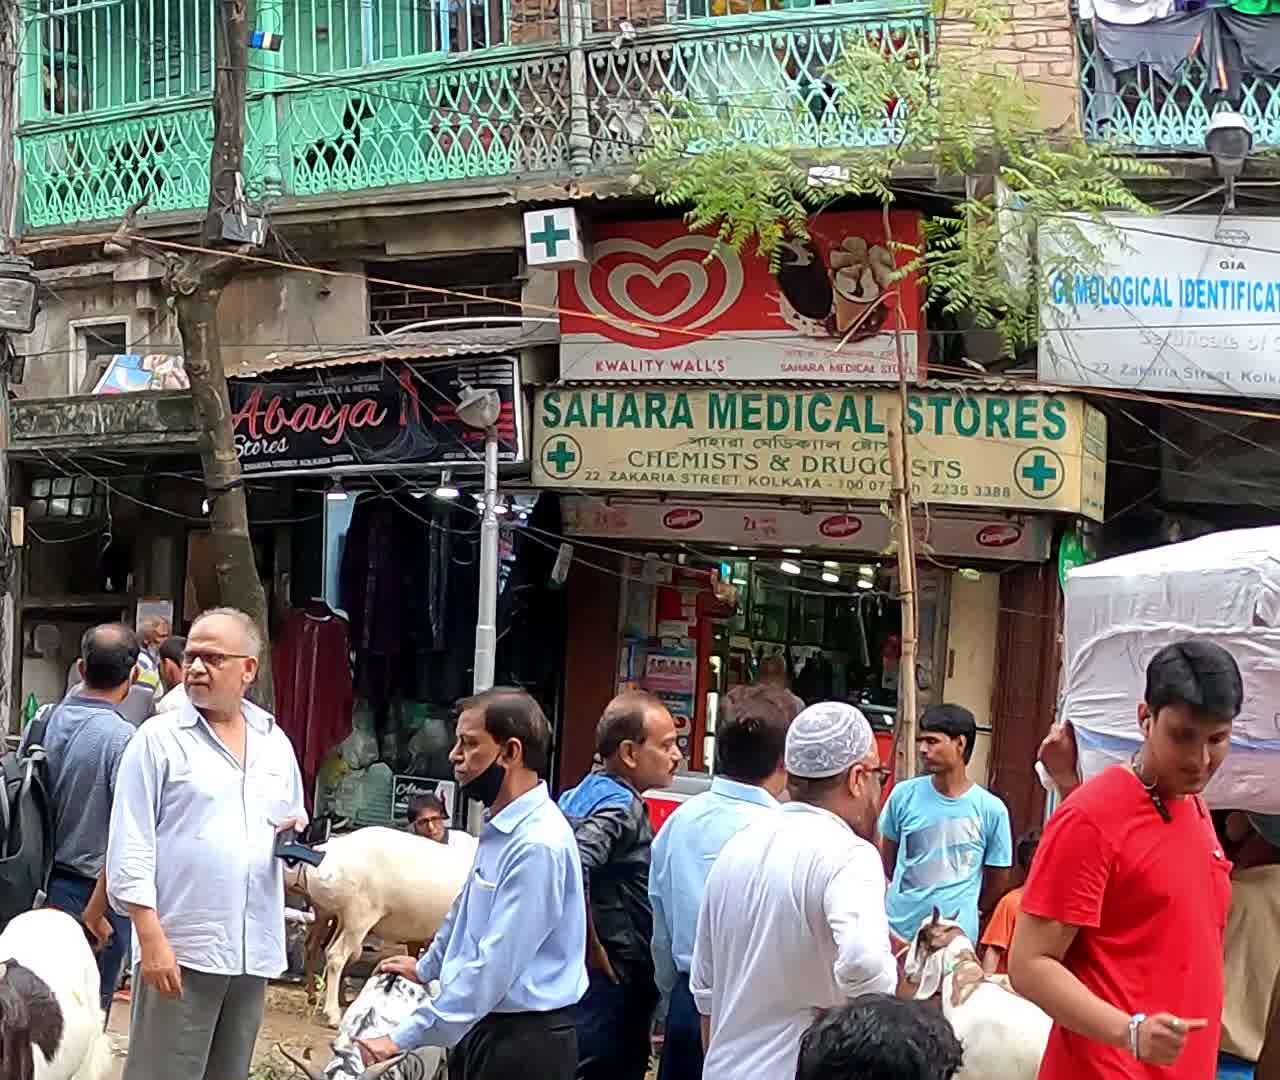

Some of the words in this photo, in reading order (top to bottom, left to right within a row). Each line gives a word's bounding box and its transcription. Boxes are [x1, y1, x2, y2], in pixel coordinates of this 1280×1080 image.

[1219, 260, 1247, 271] GIA
[1052, 274, 1173, 308] GMOLOGICAL
[595, 359, 664, 372] KWALITY
[670, 359, 726, 373] WALL'S
[232, 386, 388, 444] Abaya
[542, 391, 693, 429] SAHARA
[708, 392, 886, 434] MEDICAL
[905, 394, 1067, 441] STORES
[233, 433, 289, 458] Stores
[628, 449, 759, 471] CHEMISTS
[769, 453, 790, 472] &
[584, 470, 601, 482] 22
[608, 471, 676, 483] ZAKARIA
[748, 475, 823, 489] KOLKATA
